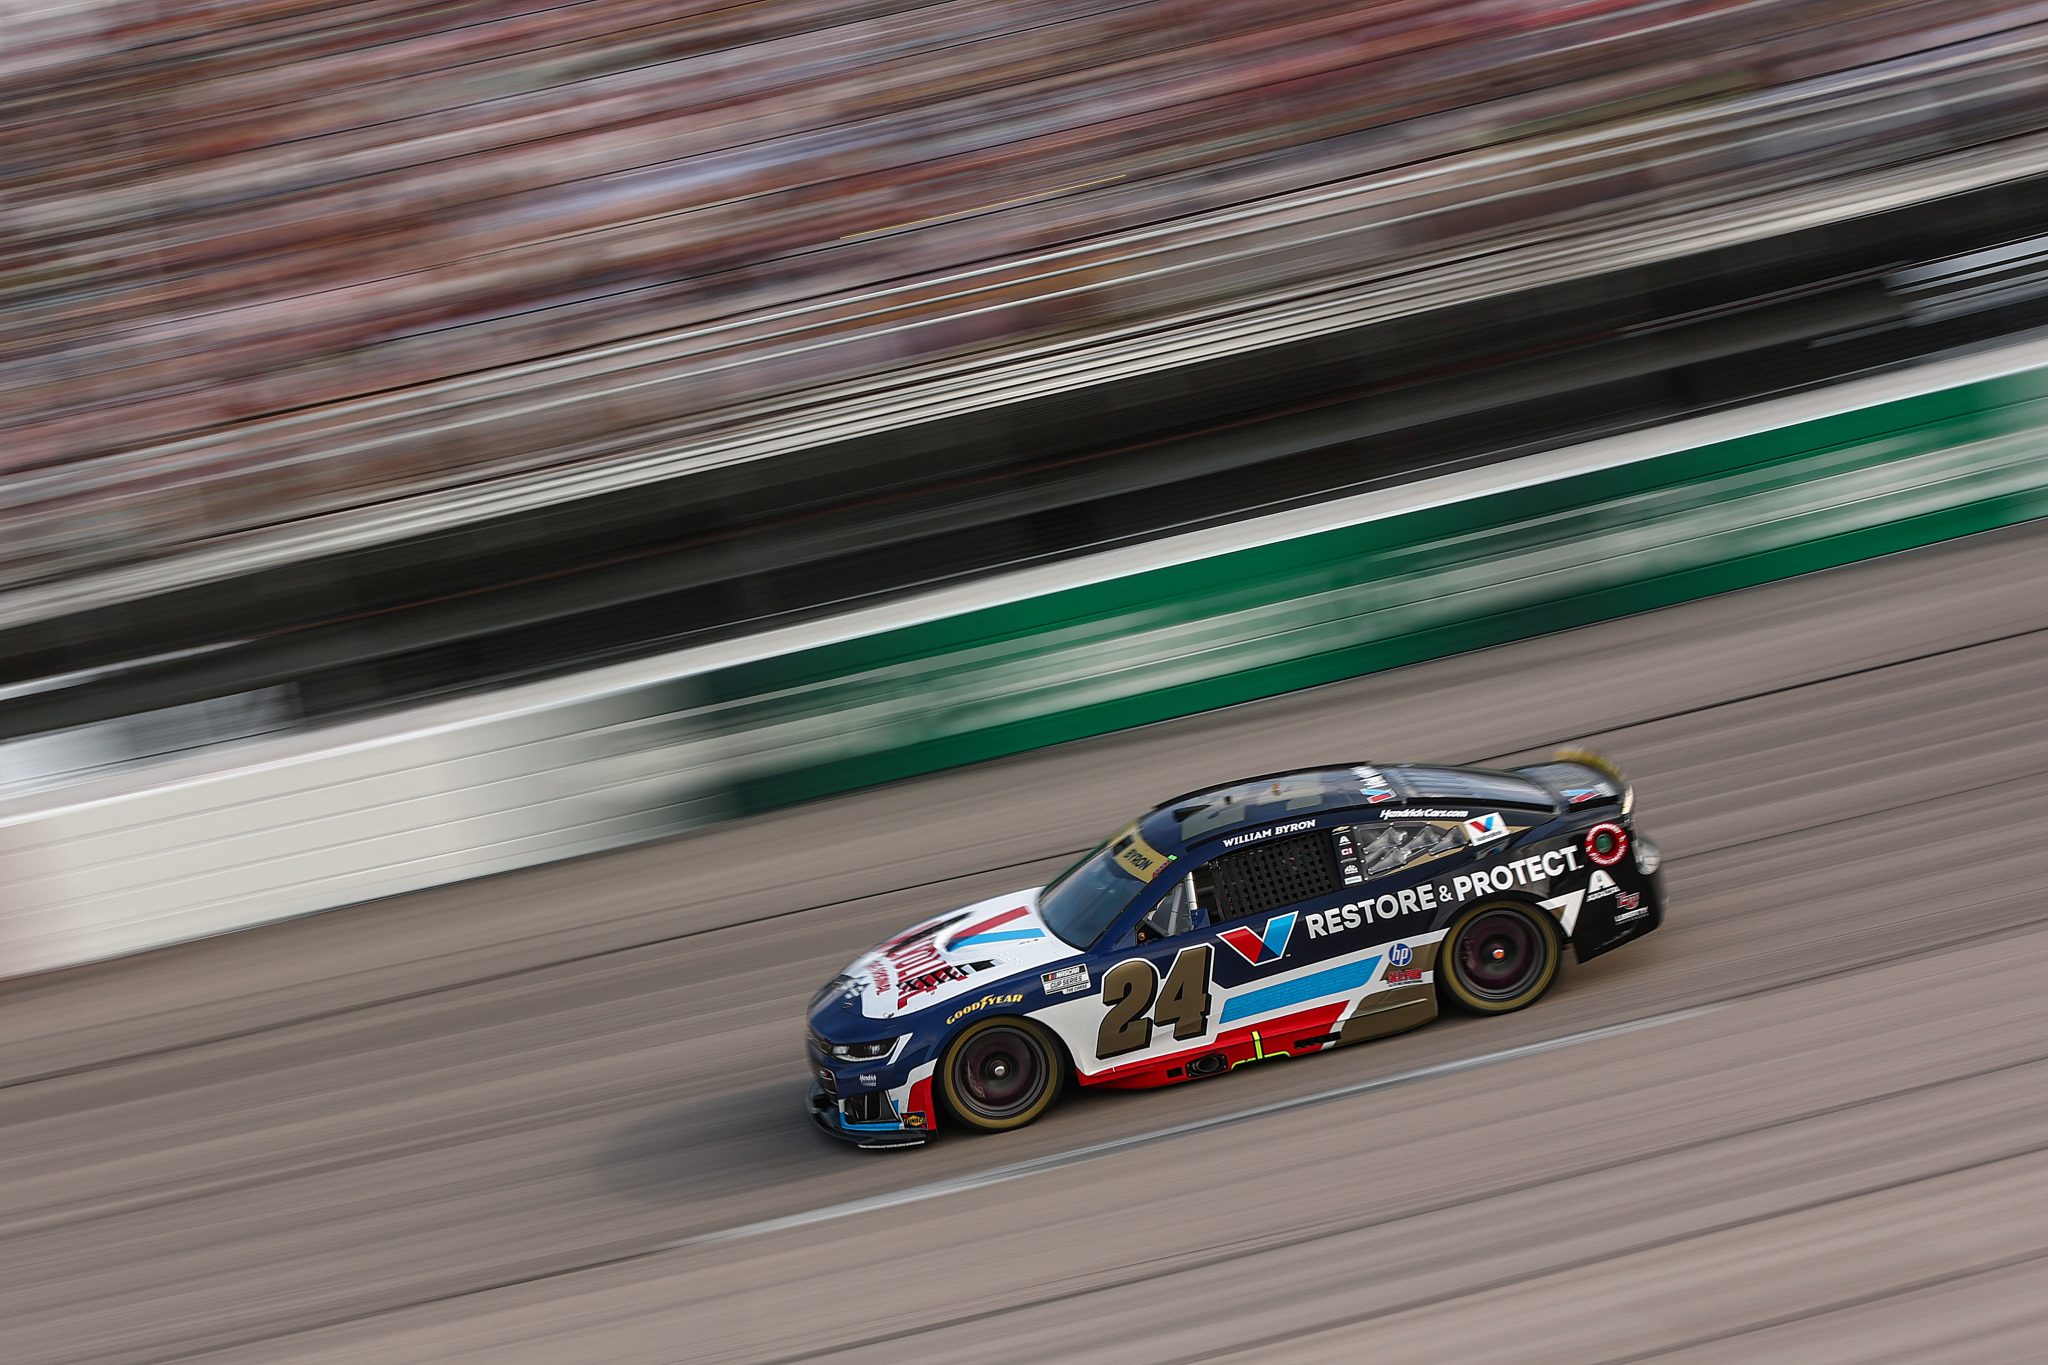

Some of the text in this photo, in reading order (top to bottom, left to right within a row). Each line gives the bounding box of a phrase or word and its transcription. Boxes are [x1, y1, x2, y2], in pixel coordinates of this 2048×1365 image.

[1380, 809, 1469, 820] HendrickCars.com
[1222, 819, 1317, 848] WILLIAM BYRON
[1123, 848, 1154, 871] BYRON
[1305, 845, 1579, 939] RESTORE & PROTECT
[1392, 944, 1409, 966] hp
[1050, 976, 1083, 989] CUP SERIES
[1055, 966, 1080, 979] NASCAR
[946, 994, 1025, 1025] GOODYEAR
[1096, 943, 1215, 1060] 24
